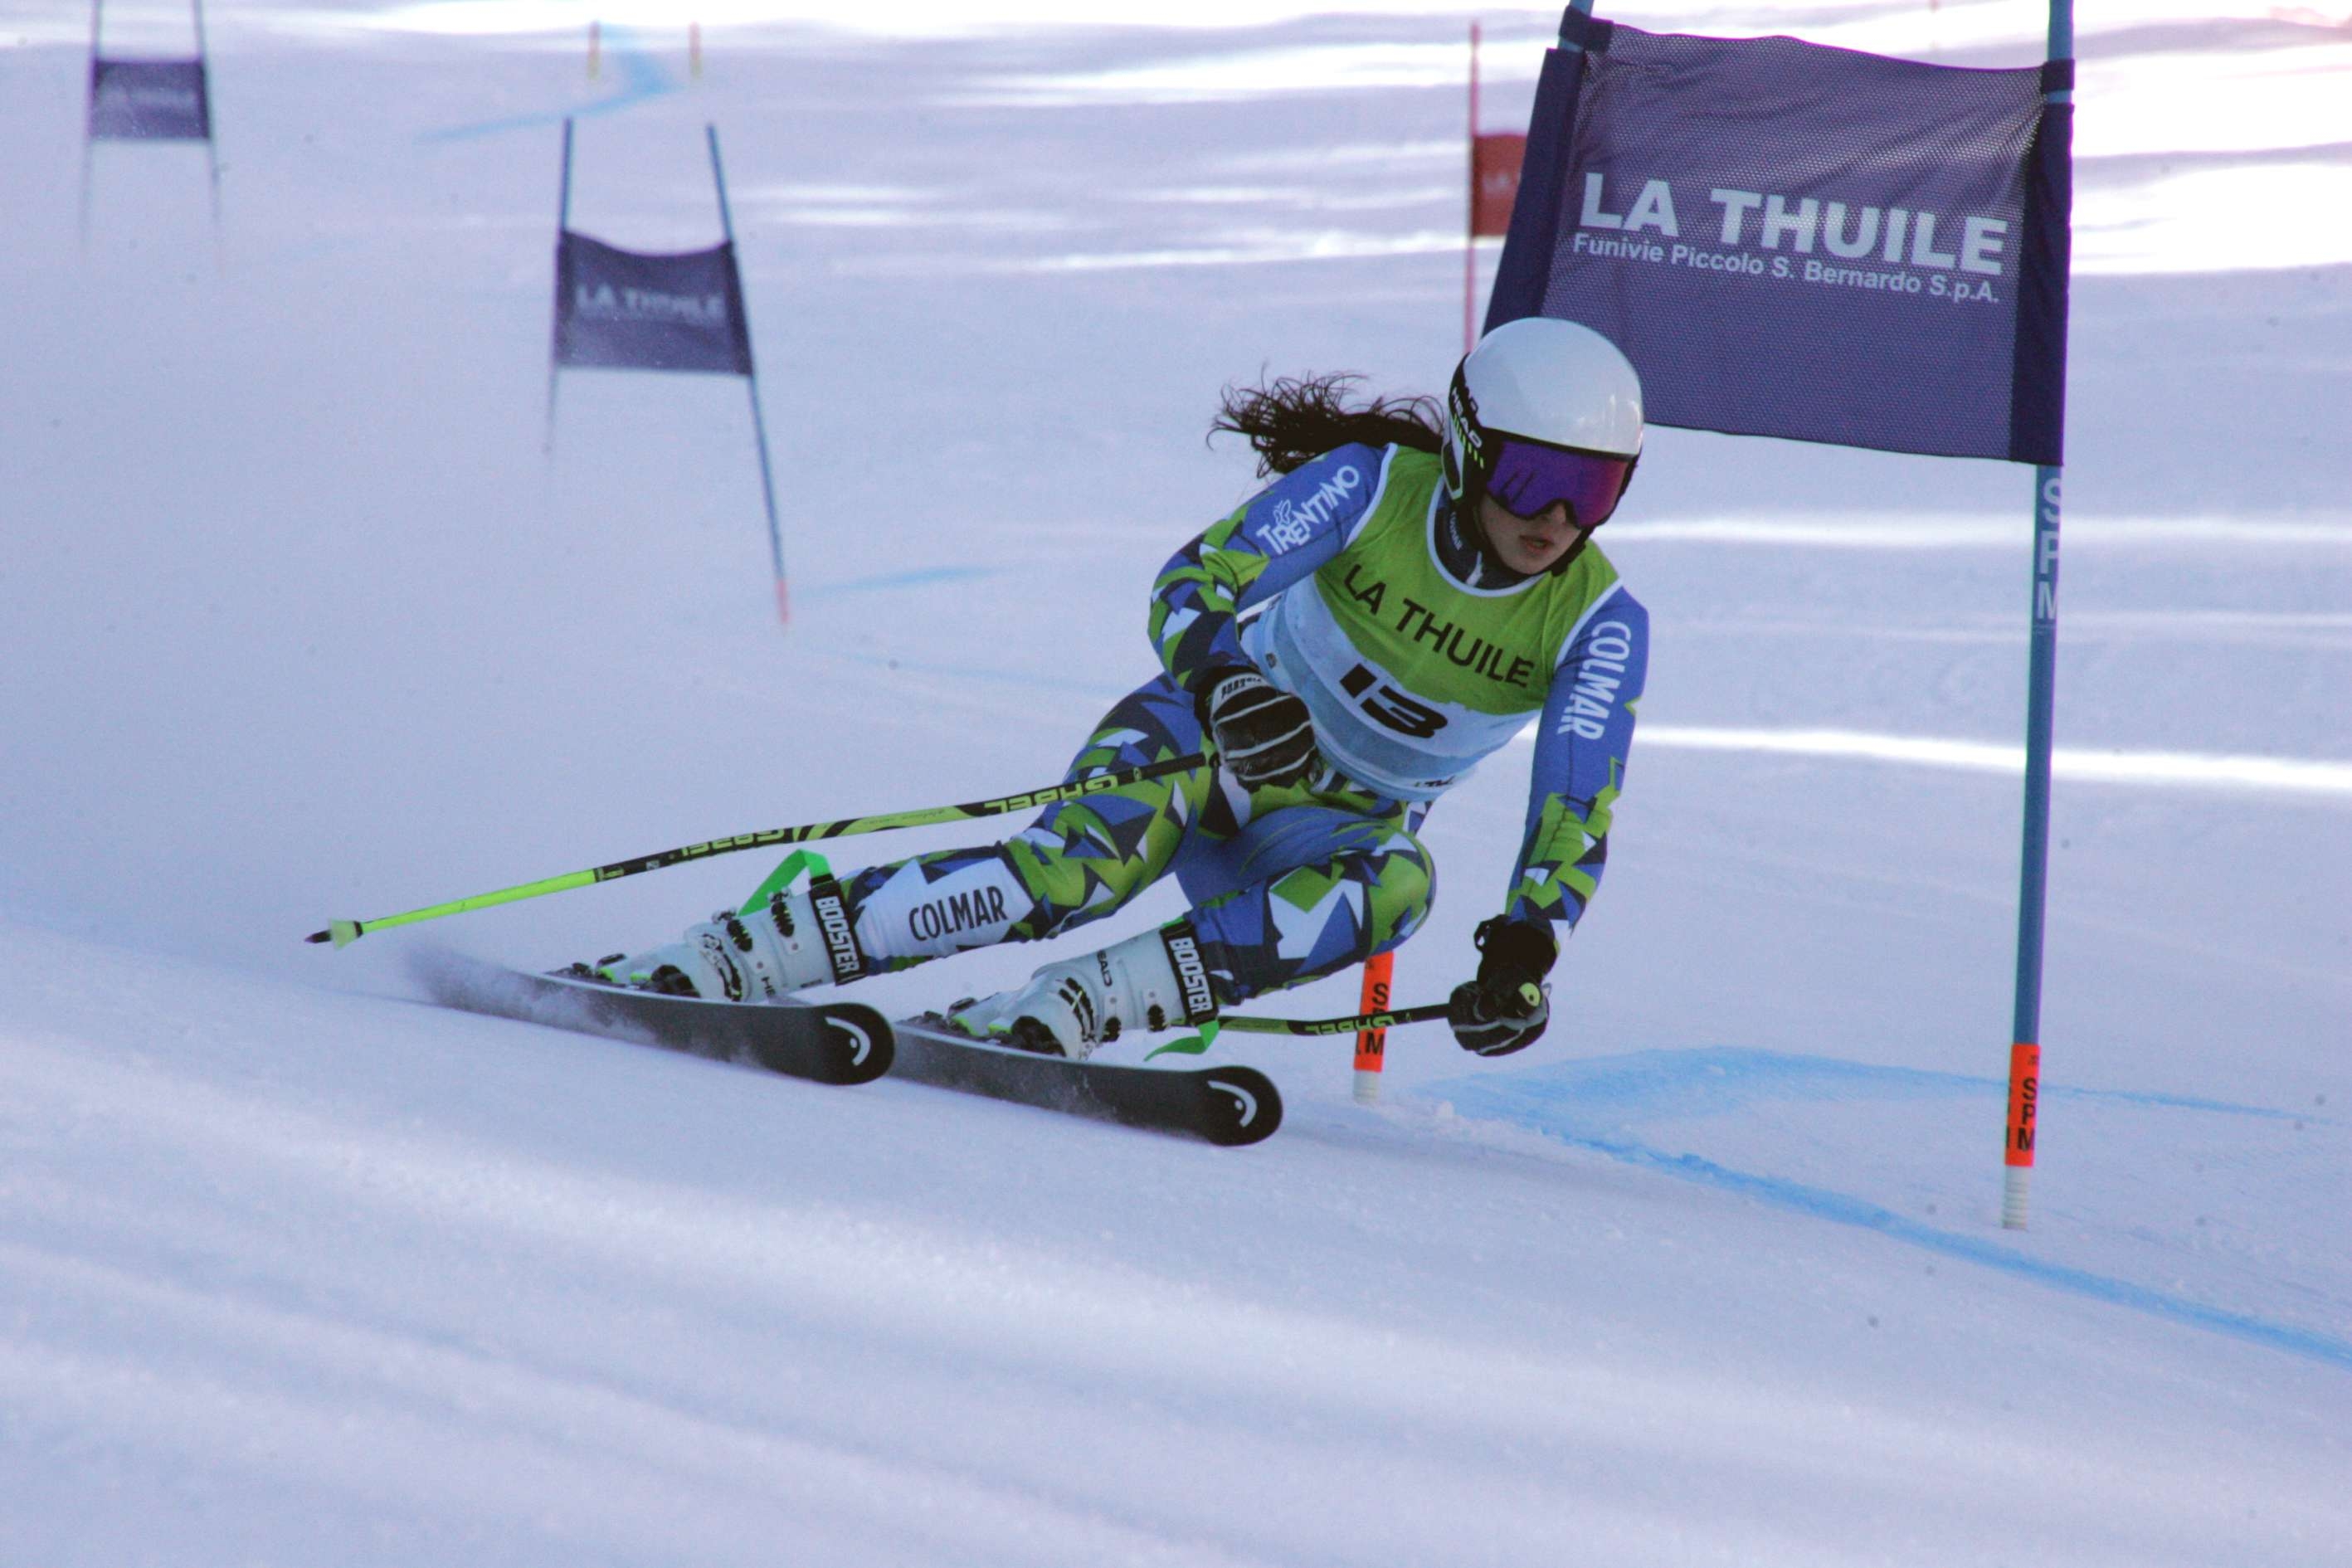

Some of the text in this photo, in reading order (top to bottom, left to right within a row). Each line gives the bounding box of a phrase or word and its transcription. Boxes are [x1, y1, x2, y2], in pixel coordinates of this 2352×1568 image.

[1580, 173, 2009, 275] LA THUILE
[1573, 231, 1999, 303] Funivie Piccolo S. Bernardo S.p.A.
[1256, 465, 1359, 555] TRENTINO
[1344, 564, 1534, 688] LA THUILE
[1340, 664, 1448, 738] 13
[1556, 621, 1631, 739] COLMAR
[815, 896, 859, 974] BOOSTER
[909, 886, 1008, 942] COLMAR
[1097, 950, 1113, 987] EAD
[1169, 937, 1213, 1015] BOOSTER
